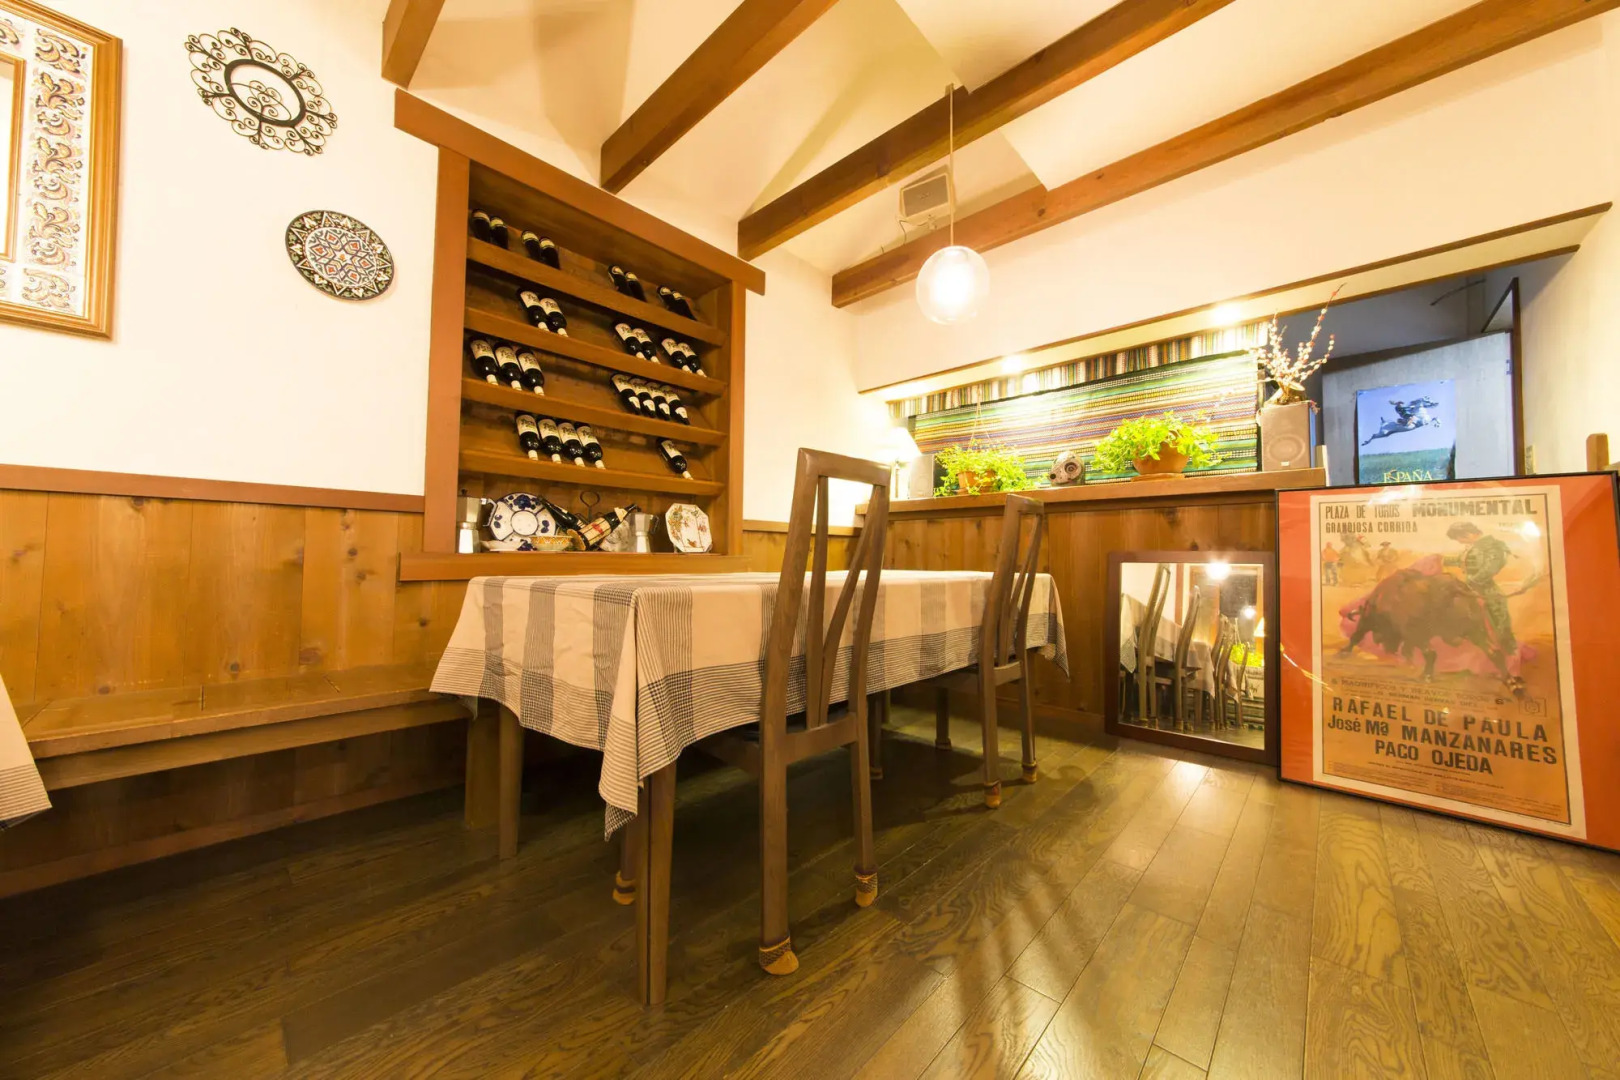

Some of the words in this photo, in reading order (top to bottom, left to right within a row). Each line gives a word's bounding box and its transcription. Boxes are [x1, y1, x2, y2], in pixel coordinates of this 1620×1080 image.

[1325, 505, 1349, 519] PLAZA
[1356, 504, 1366, 518] DE
[1374, 503, 1400, 518] TOROS
[1412, 499, 1537, 517] MONUMENTAL
[1325, 521, 1373, 533] GRANDIOSA
[1377, 520, 1418, 533] CORRIDA
[1333, 697, 1412, 722] RAFAEL
[1424, 709, 1448, 728] DE
[1463, 715, 1547, 742] PAULA
[1328, 714, 1361, 732] José
[1402, 725, 1557, 764] MANZANARES
[1375, 739, 1419, 760] PACO
[1432, 749, 1493, 775] OJEDA
